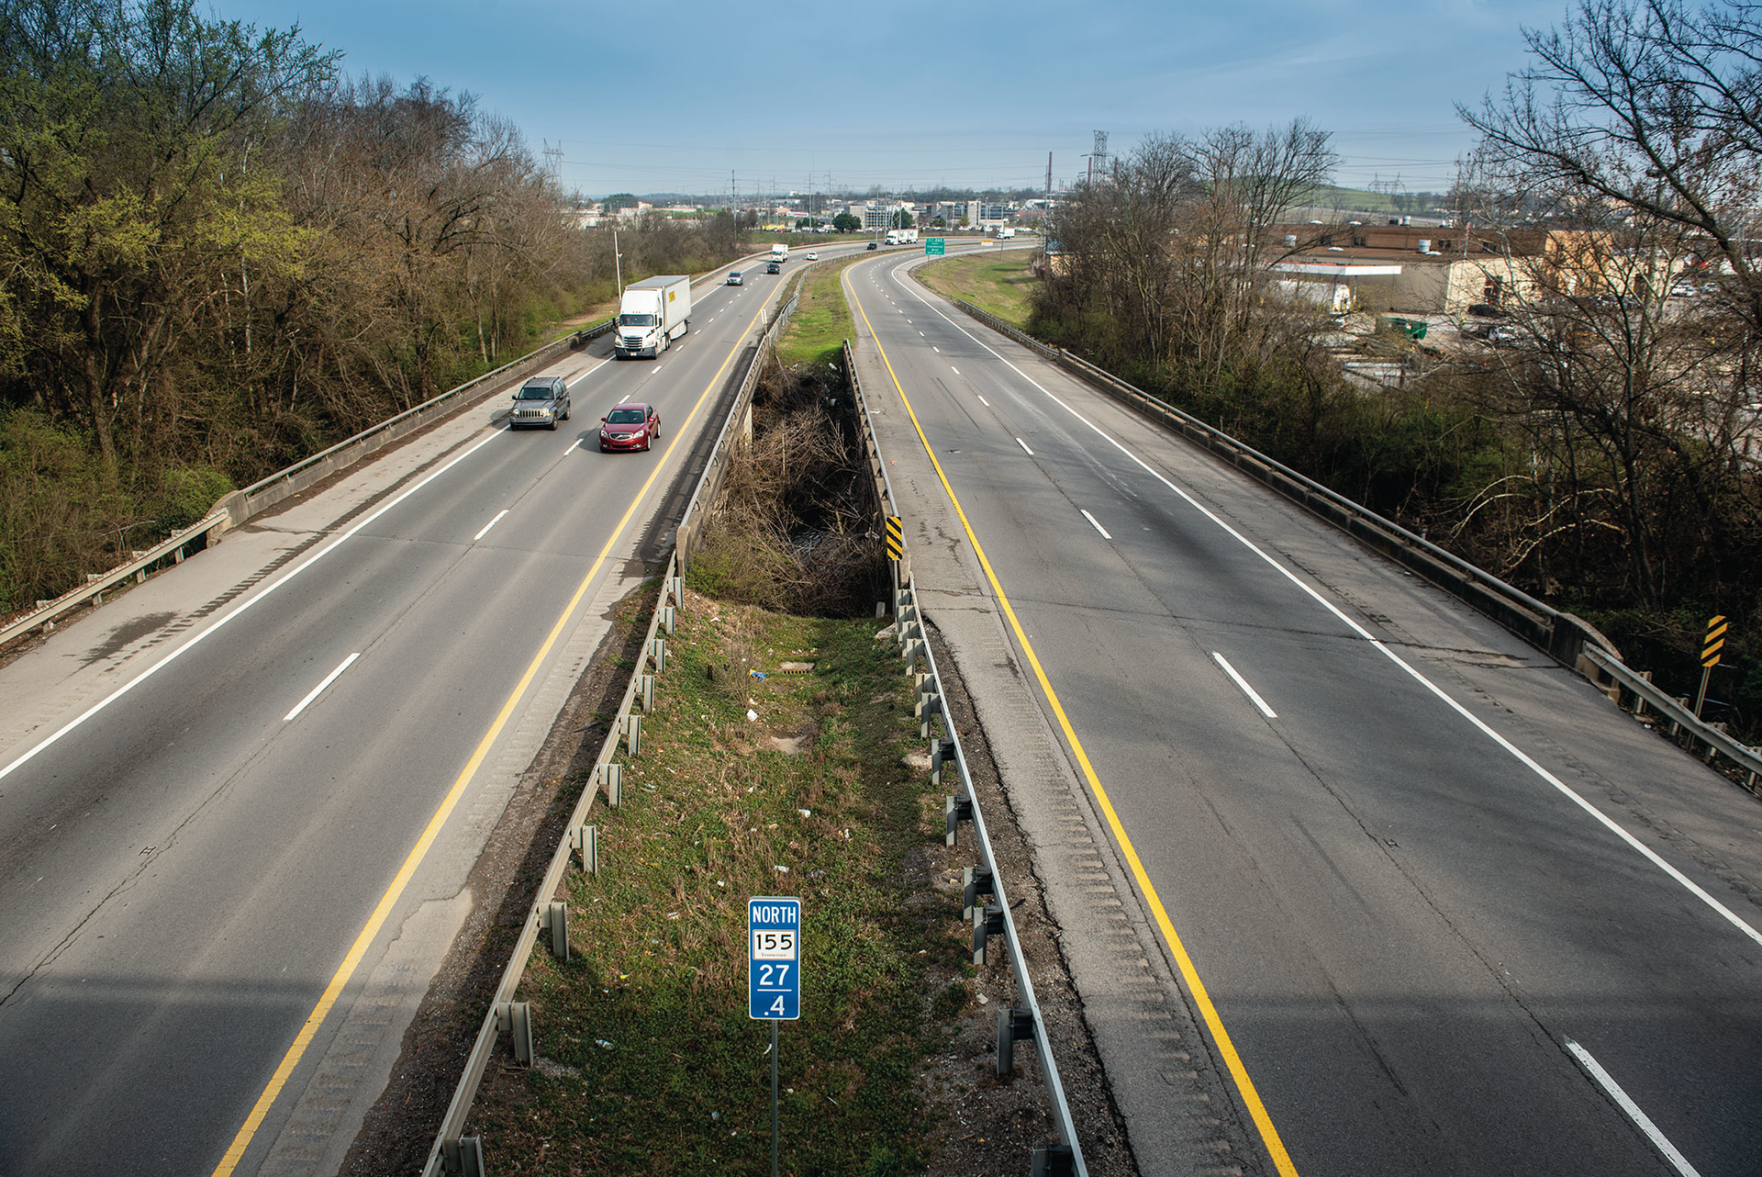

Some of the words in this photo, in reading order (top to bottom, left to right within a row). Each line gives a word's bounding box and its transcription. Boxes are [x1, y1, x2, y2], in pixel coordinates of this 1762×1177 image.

[753, 906, 796, 923] NORTH
[756, 934, 793, 950] 155
[759, 964, 790, 986] 27
[764, 995, 785, 1016] .4
